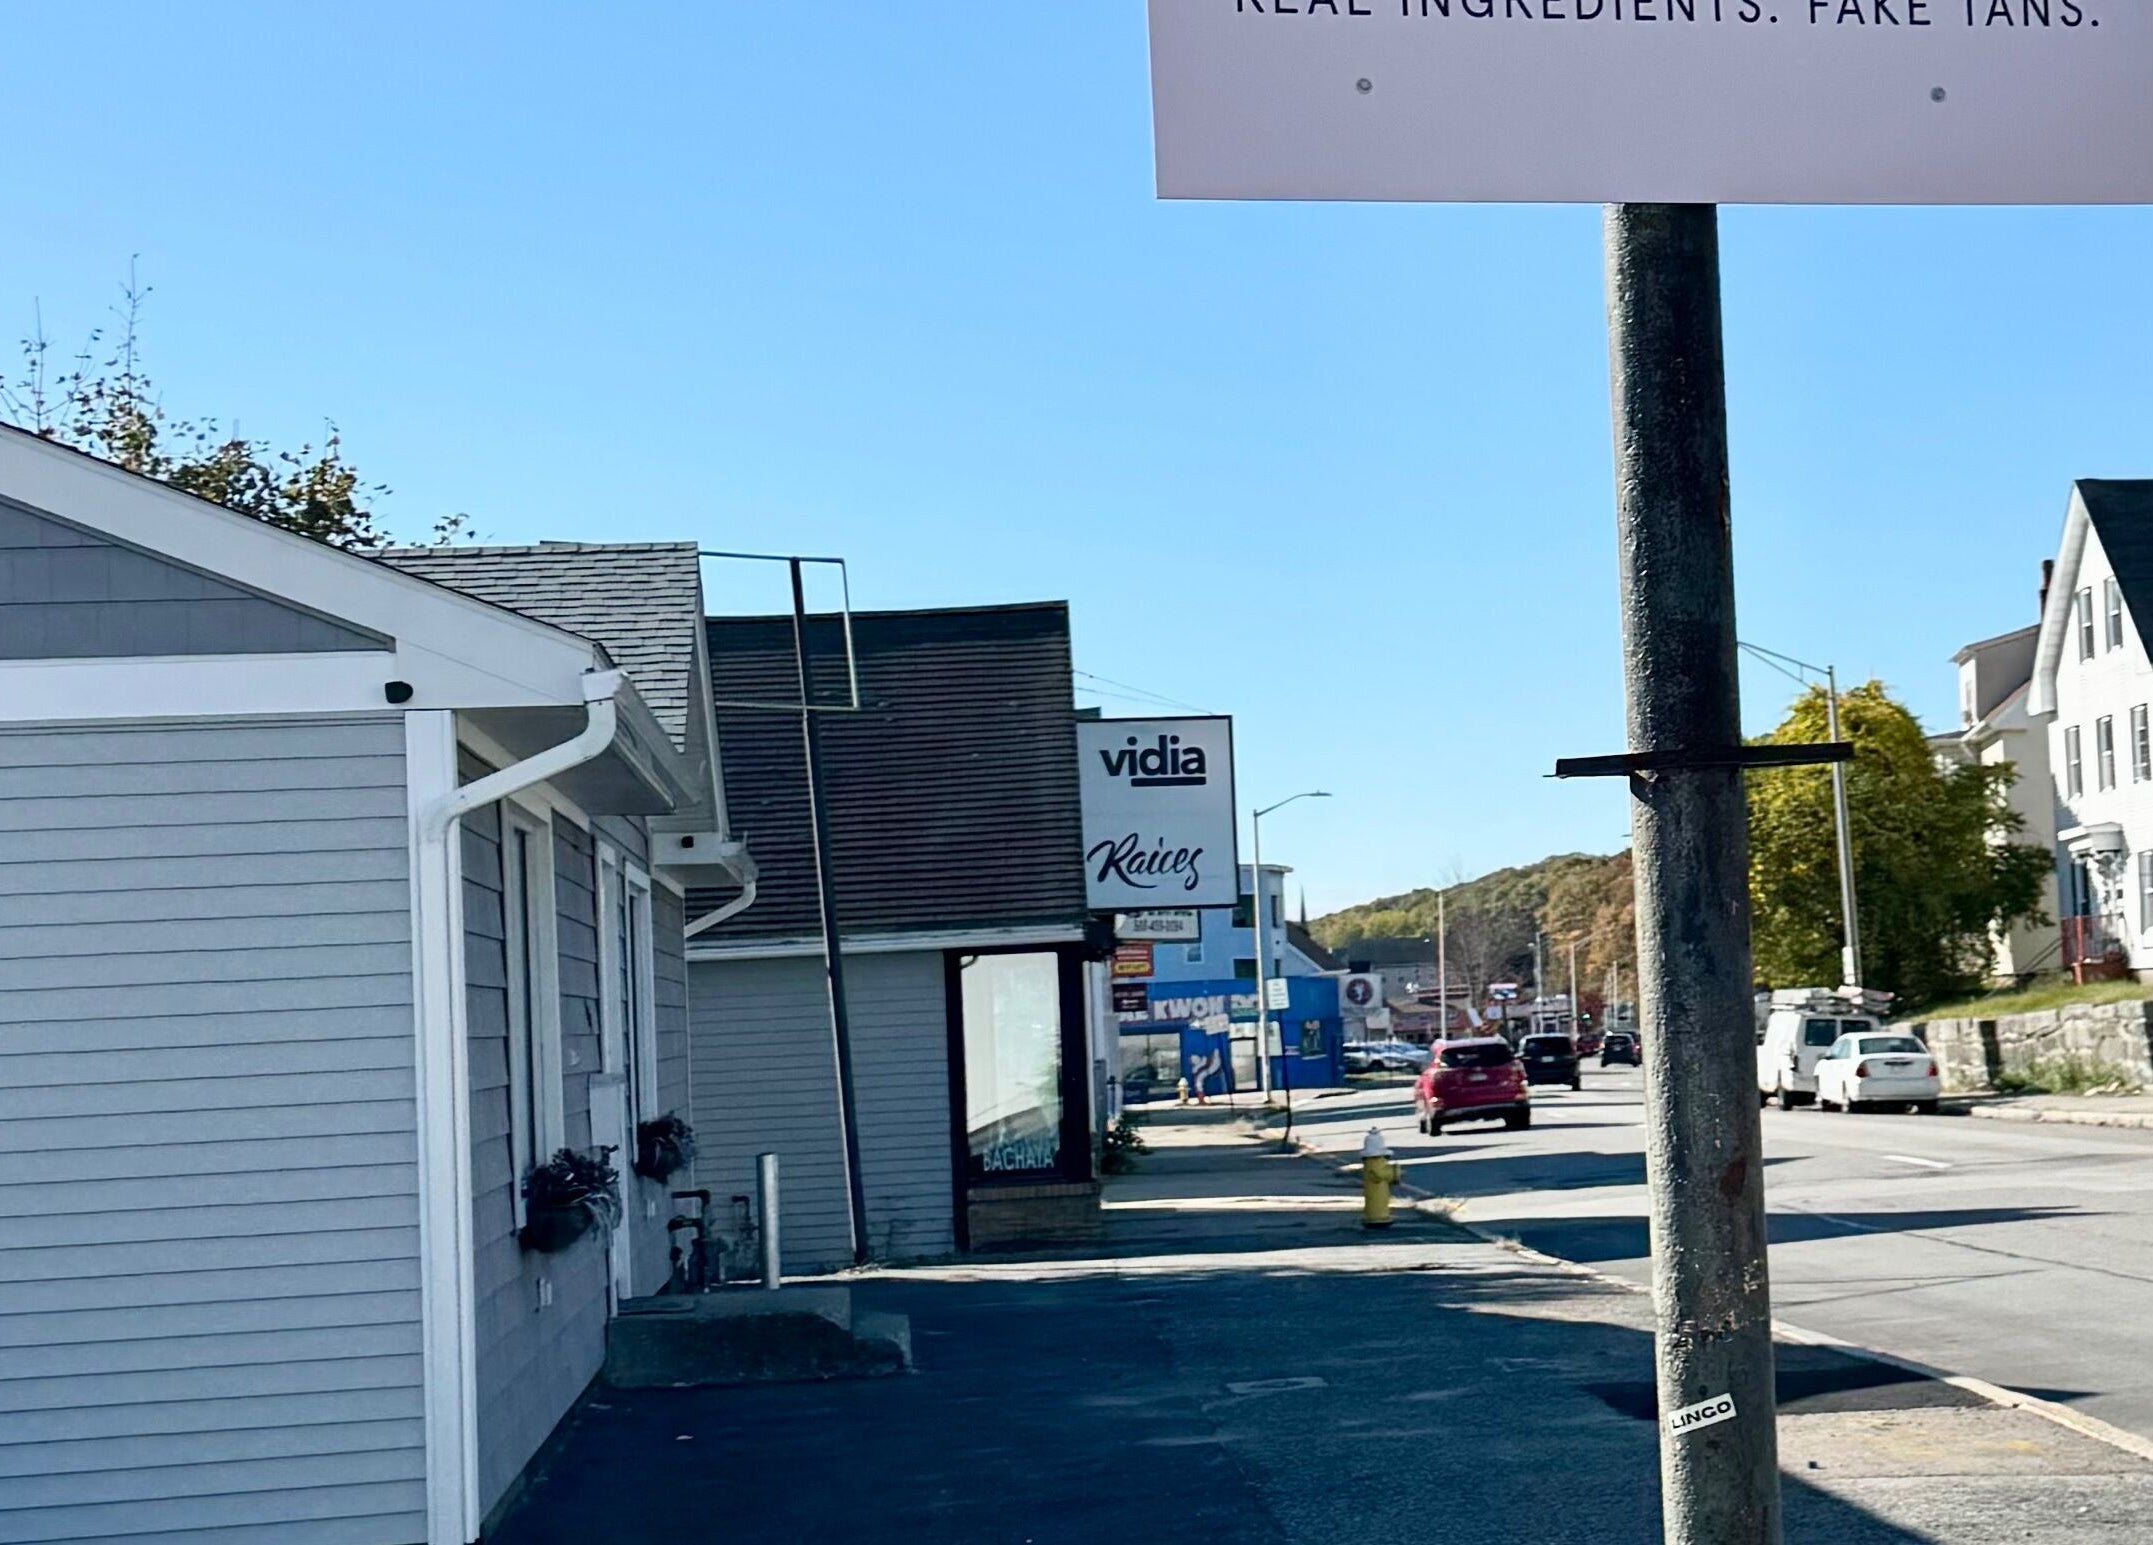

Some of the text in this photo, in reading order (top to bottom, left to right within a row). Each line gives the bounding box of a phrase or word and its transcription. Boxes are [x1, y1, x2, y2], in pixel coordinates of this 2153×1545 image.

[1808, 0, 1932, 26] FAKE
[1099, 734, 1206, 777] vidia
[1672, 1401, 1732, 1429] LINGO
